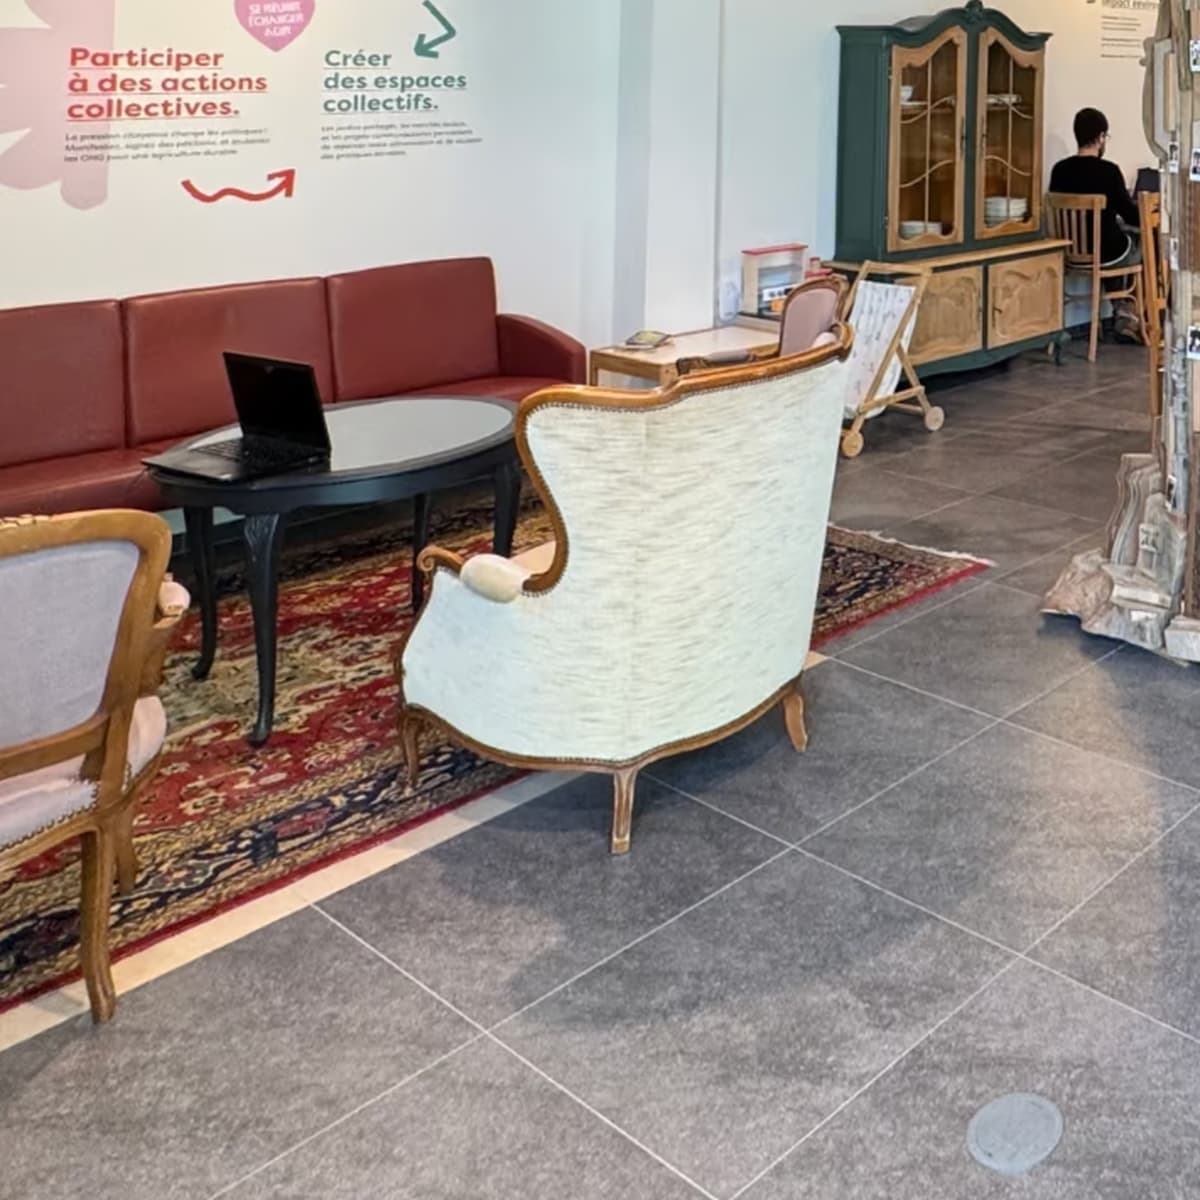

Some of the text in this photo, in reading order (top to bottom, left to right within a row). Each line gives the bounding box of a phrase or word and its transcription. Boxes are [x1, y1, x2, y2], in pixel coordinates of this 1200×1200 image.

[69, 47, 225, 71] Participer
[324, 49, 392, 67] Créer
[68, 72, 268, 93] à des actions
[324, 73, 468, 93] des espaces
[67, 98, 240, 119] collectives.
[323, 94, 439, 112] collectifs.
